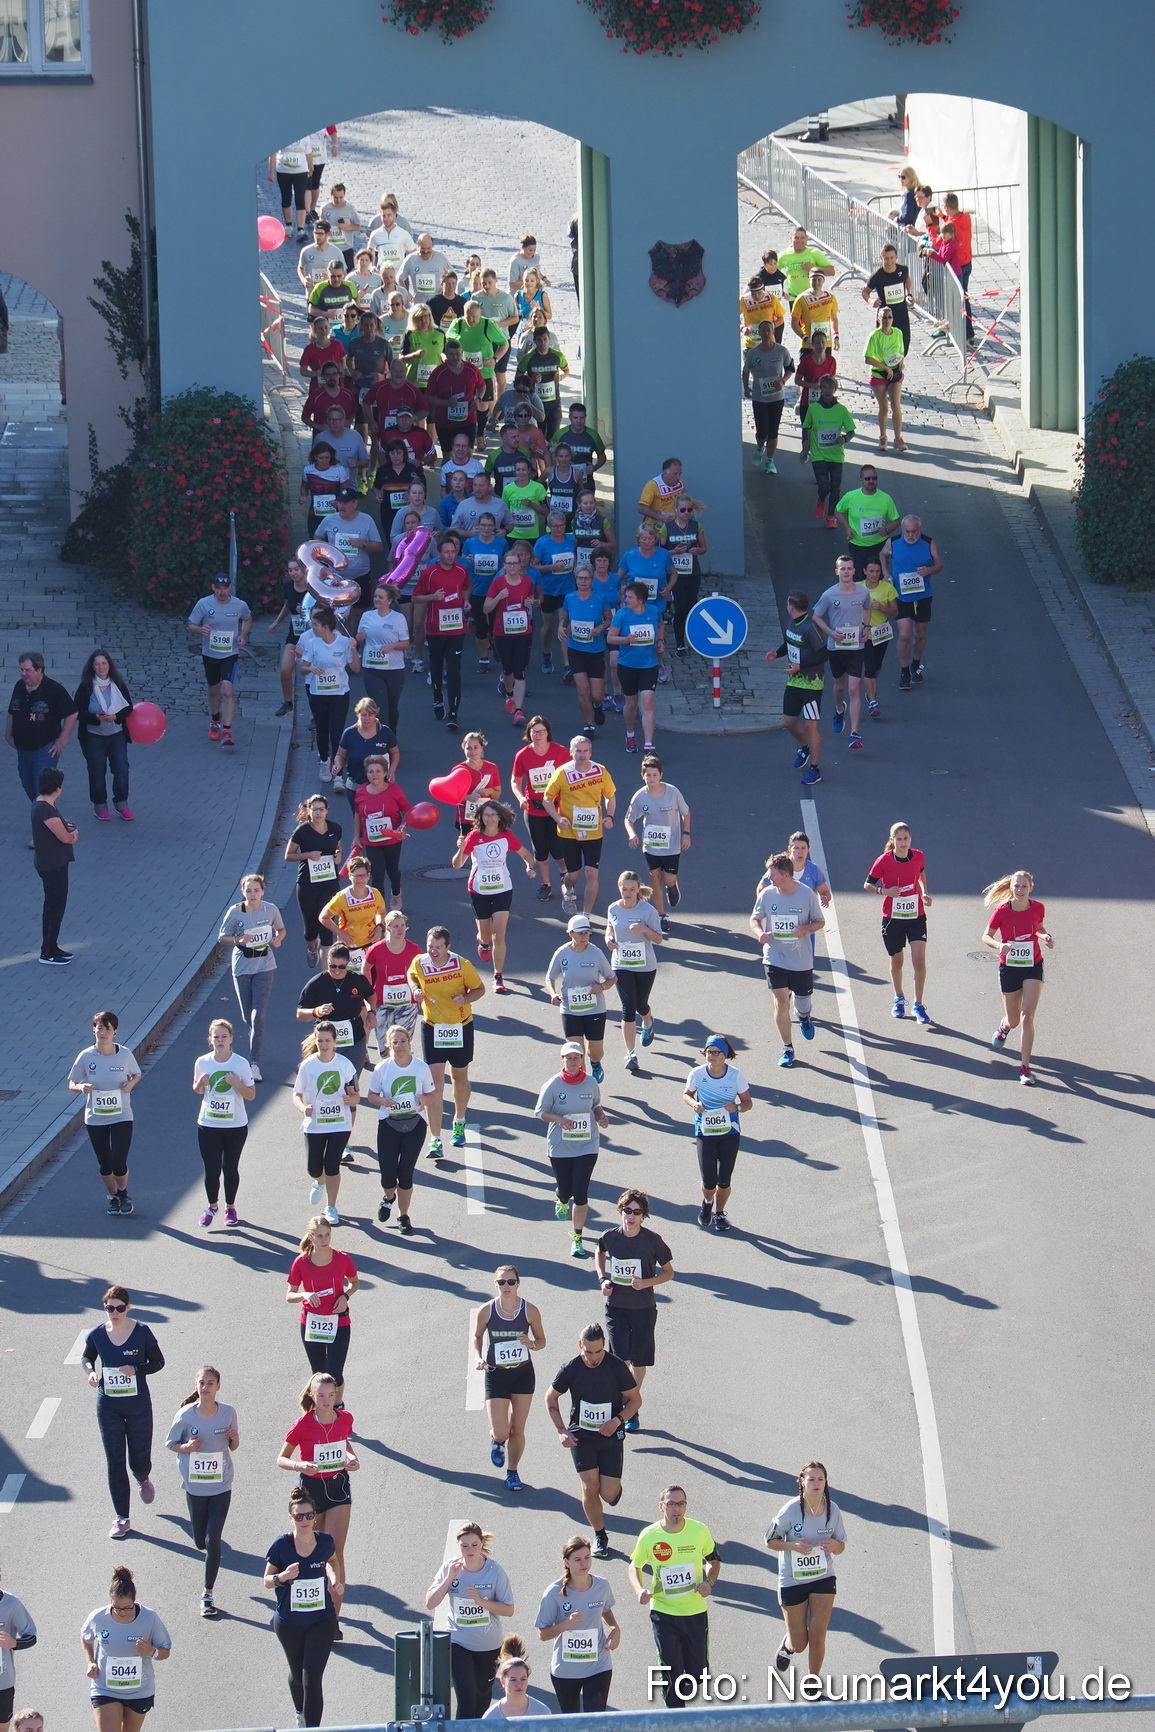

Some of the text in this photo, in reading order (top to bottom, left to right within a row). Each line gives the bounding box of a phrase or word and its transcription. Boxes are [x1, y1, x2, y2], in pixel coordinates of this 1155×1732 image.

[285, 156, 300, 164] 5191
[383, 250, 400, 258] 5192
[887, 290, 903, 298] 5183
[323, 296, 350, 304] BOCK
[537, 386, 554, 395] 5149
[450, 406, 467, 415] 5117
[820, 432, 838, 441] 5029
[553, 500, 571, 509] 5150
[516, 514, 533, 523] 5080
[863, 520, 881, 531] 5217
[668, 534, 698, 543] BOCK
[477, 559, 496, 569] 5042
[672, 557, 690, 567] 5143
[902, 576, 922, 587] 5208
[442, 613, 461, 623] 5116
[506, 617, 526, 627] 5115
[573, 627, 592, 638] 5039
[633, 628, 652, 639] 5041
[873, 627, 890, 638] 5151
[212, 635, 232, 645] 5198
[367, 650, 387, 660] 5103
[319, 674, 338, 685] 5102
[533, 772, 553, 783] 5174
[569, 782, 587, 792] MAX
[576, 812, 597, 823] 5097
[647, 830, 668, 841] 5045
[312, 861, 332, 872] 5034
[481, 873, 501, 884] 5166
[895, 901, 915, 911] 5108
[774, 920, 796, 931] 5219
[621, 949, 642, 959] 5043
[1009, 947, 1031, 957] 5109
[441, 972, 463, 982] BÖGL
[387, 990, 407, 1001] 5107
[571, 993, 593, 1003] 5193
[437, 1028, 459, 1039] 5099
[95, 1096, 118, 1107] 5100
[209, 1099, 231, 1111] 5047
[390, 1100, 412, 1112] 5048
[319, 1105, 341, 1116] 5049
[571, 1119, 588, 1130] 019
[705, 1116, 727, 1127] 5064
[614, 1264, 637, 1276] 5197
[310, 1320, 334, 1333] 5123
[499, 1347, 523, 1361] 5147
[108, 1374, 132, 1386] 5136
[583, 1408, 606, 1421] 5011
[318, 1449, 342, 1462] 5110
[194, 1460, 218, 1472] 5179
[310, 1562, 321, 1570] vhs
[796, 1555, 821, 1569] 5007
[666, 1571, 693, 1586] 5214
[296, 1587, 320, 1600] 5135
[458, 1604, 484, 1617] 5008
[567, 1638, 594, 1650] 5094
[111, 1665, 138, 1678] 5044
